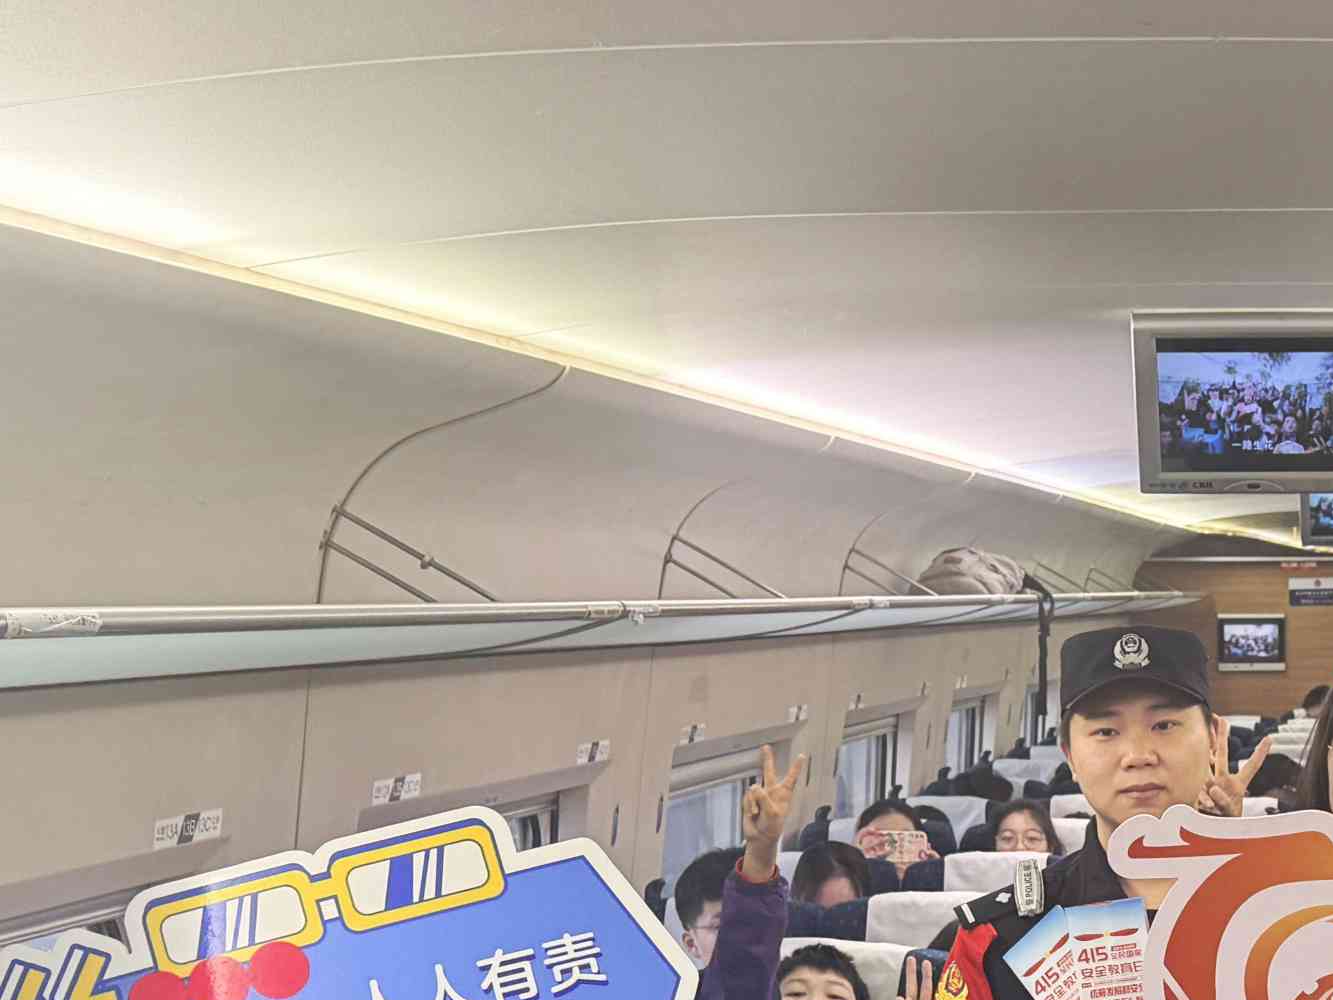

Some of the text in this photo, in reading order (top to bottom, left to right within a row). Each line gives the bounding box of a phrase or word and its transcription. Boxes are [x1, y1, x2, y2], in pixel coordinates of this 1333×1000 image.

[1023, 871, 1033, 898] POLICE
[1078, 945, 1109, 964] 415
[1034, 966, 1060, 996] 415
